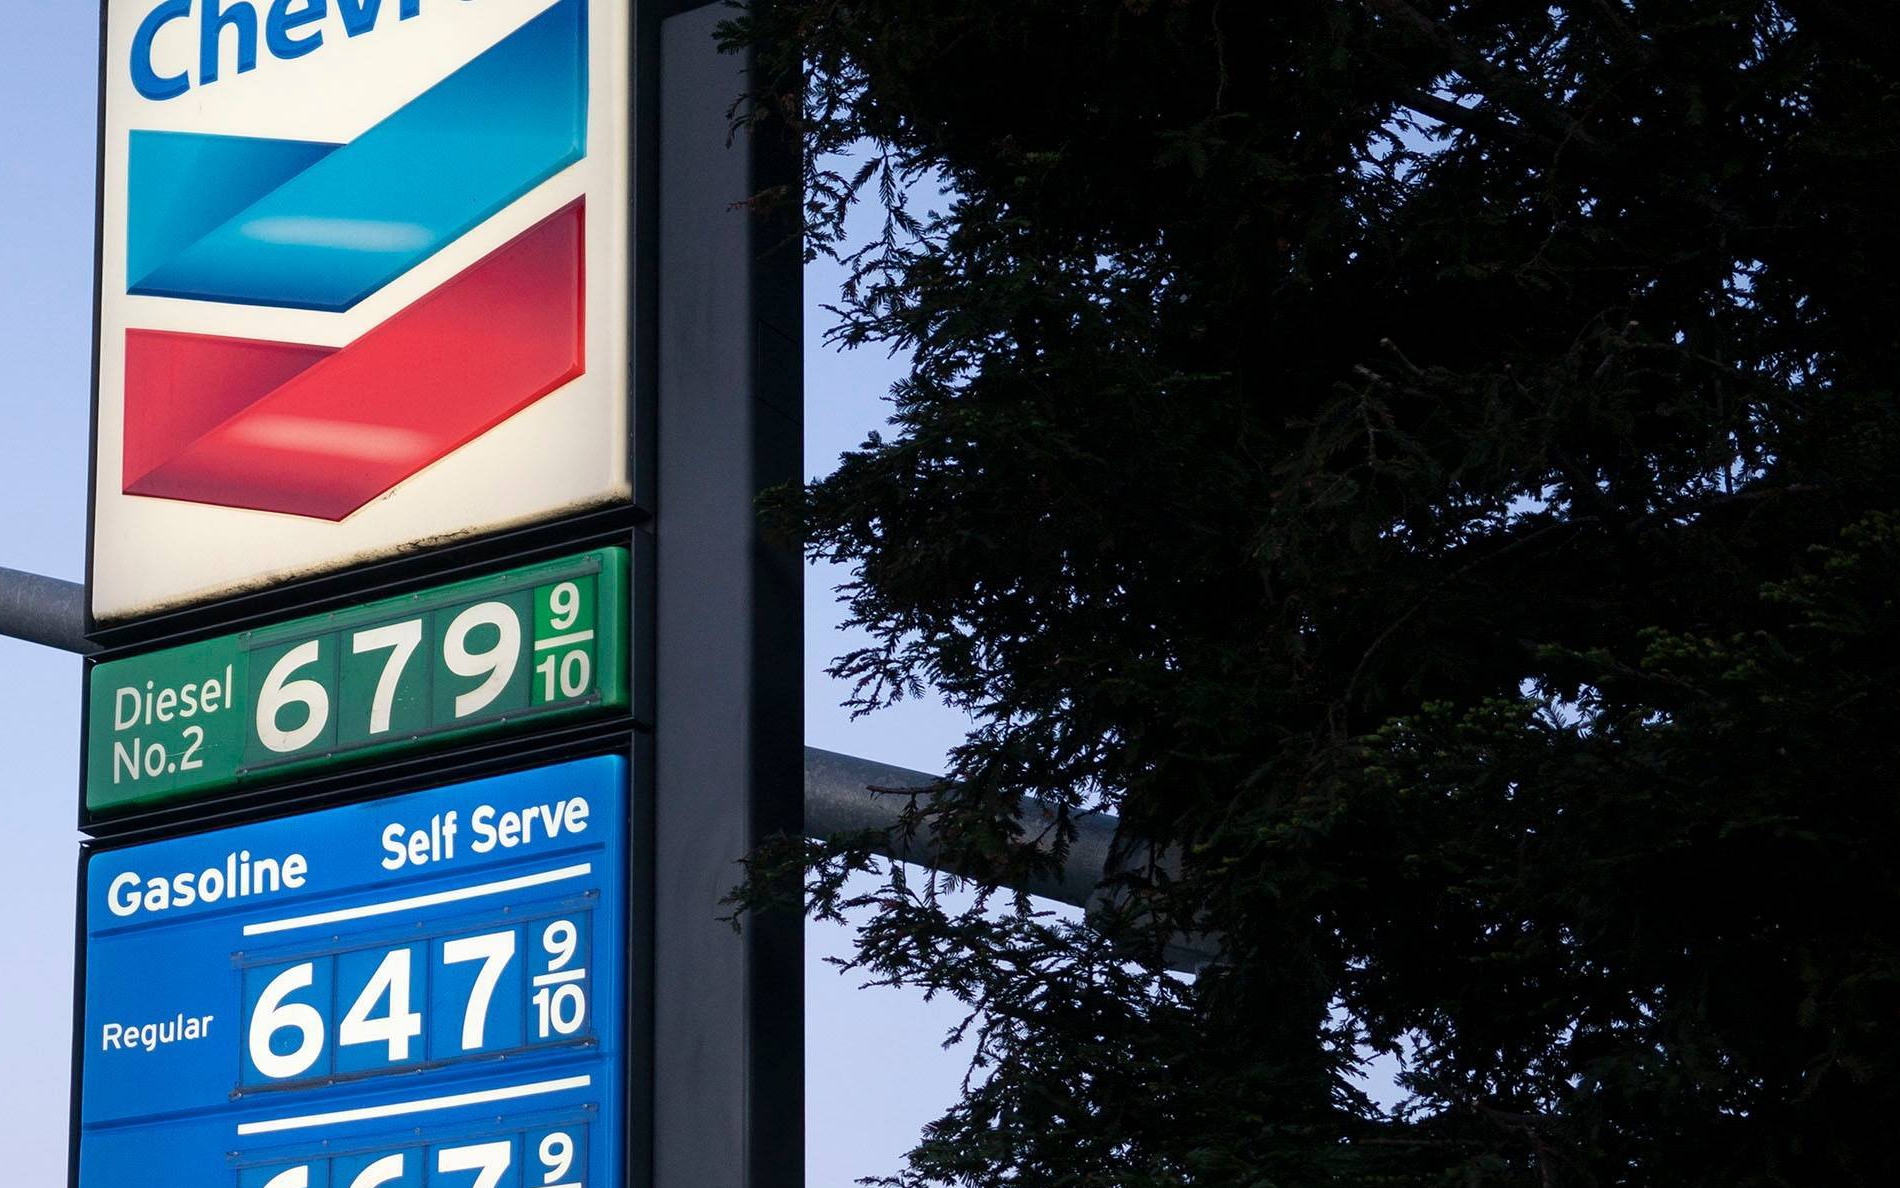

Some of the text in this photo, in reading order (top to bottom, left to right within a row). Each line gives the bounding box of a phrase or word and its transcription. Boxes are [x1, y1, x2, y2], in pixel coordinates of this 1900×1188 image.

[549, 582, 580, 630] 9
[114, 663, 233, 731] Diesel
[255, 602, 522, 753] 679
[535, 649, 590, 702] 10
[113, 725, 204, 784] No.2
[381, 796, 590, 870] Self Serve
[107, 850, 308, 917] Gasoline
[542, 919, 578, 972] 9
[102, 930, 516, 1079] Regular 647
[532, 983, 586, 1038] 10
[538, 1131, 574, 1185] 9
